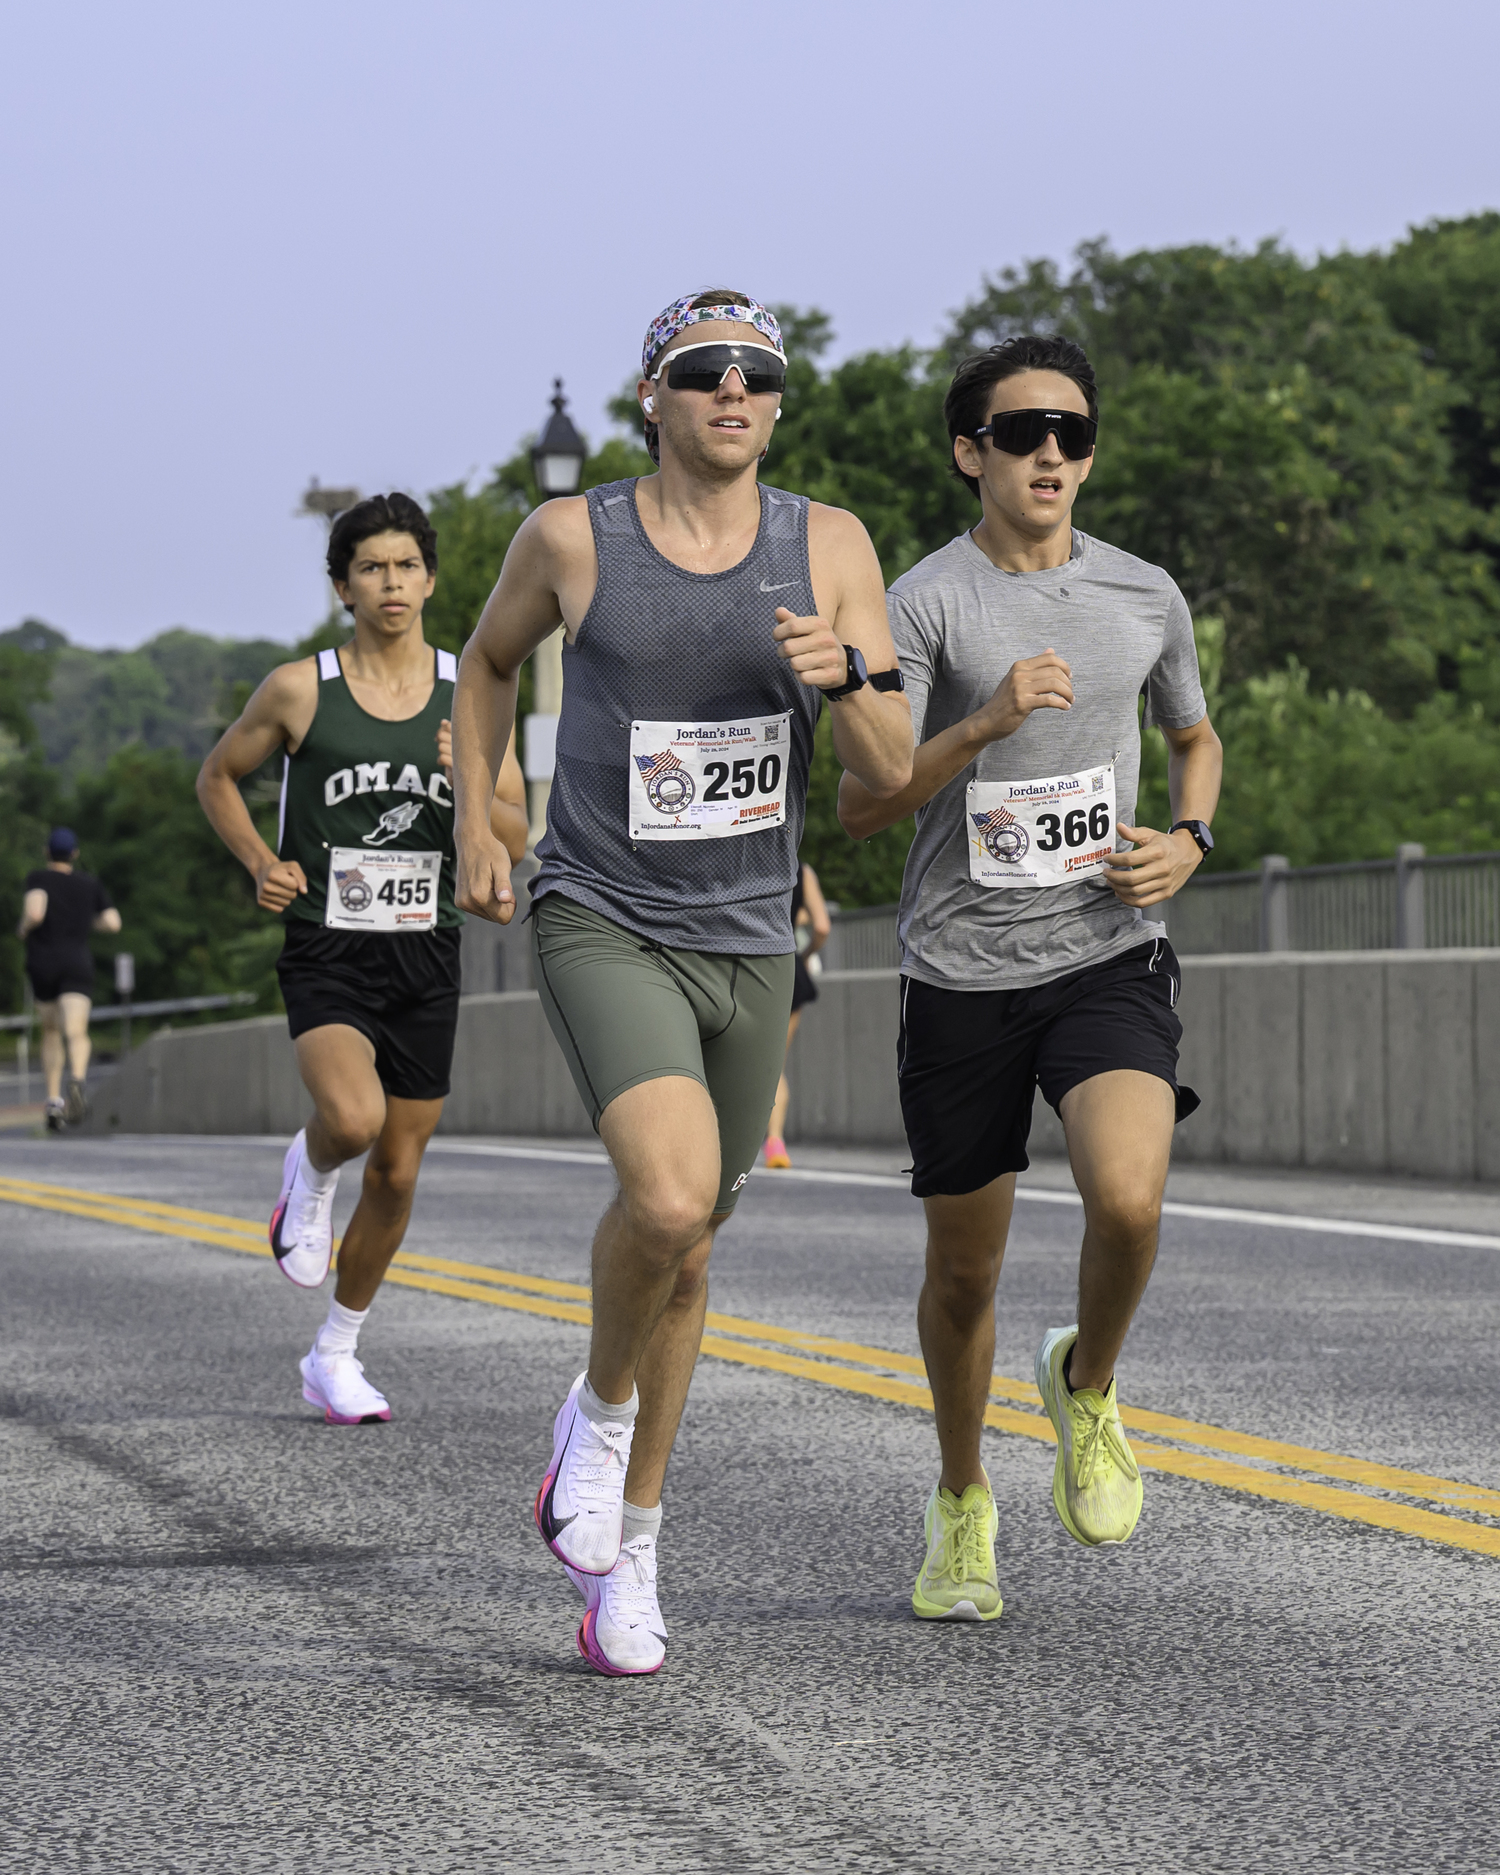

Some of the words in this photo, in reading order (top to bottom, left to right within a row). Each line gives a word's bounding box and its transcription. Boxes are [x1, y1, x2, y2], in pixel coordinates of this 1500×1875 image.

[676, 728, 726, 740] Jordan's
[728, 727, 751, 737] Run
[731, 736, 757, 745] Run/Walk
[324, 761, 453, 808] OMAC
[679, 773, 691, 786] RUN
[703, 754, 781, 802] 250
[1009, 783, 1055, 798] Jordan's
[1057, 780, 1080, 791] Run
[1028, 794, 1053, 802] Memorial
[1061, 788, 1085, 798] Run/Walk
[740, 801, 780, 818] RIVERHEAD
[1014, 826, 1025, 837] RUN
[1036, 802, 1109, 851] 366
[362, 854, 395, 863] Jordan's
[397, 855, 414, 863] Run
[1073, 846, 1112, 865] RIVERHEAD
[377, 878, 432, 906] 455
